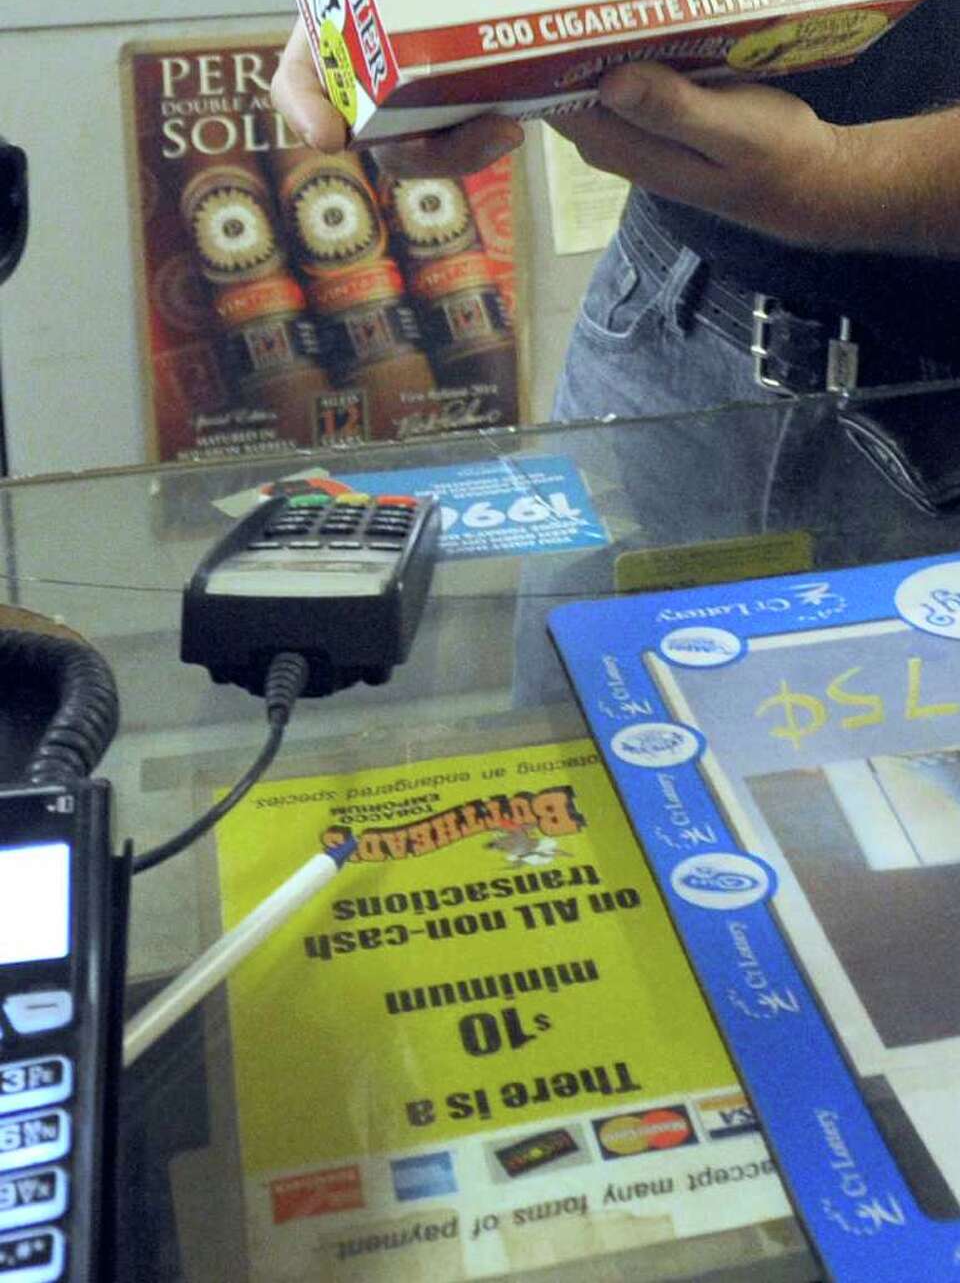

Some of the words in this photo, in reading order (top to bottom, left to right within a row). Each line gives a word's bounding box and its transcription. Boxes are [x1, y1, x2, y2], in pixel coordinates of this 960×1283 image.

[479, 20, 533, 51] 200
[161, 52, 283, 98] PER
[161, 96, 242, 116] DOUBLE
[656, 600, 750, 624] Lottery
[481, 768, 509, 784] an
[514, 753, 603, 779] otecting
[344, 771, 472, 802] endangered
[329, 791, 441, 817] EMPORIUM
[338, 802, 434, 824] TOBACCO
[332, 863, 602, 920] transactions
[593, 887, 642, 913] on
[514, 897, 580, 930] ALL
[304, 909, 508, 960] non-cash
[384, 958, 600, 1015] minimum
[458, 1007, 552, 1058] $10
[503, 1061, 643, 1108] There
[405, 1100, 437, 1126] a
[445, 1088, 492, 1121] is
[602, 1177, 676, 1207] many
[512, 1193, 589, 1223] forms
[470, 1211, 501, 1242] of
